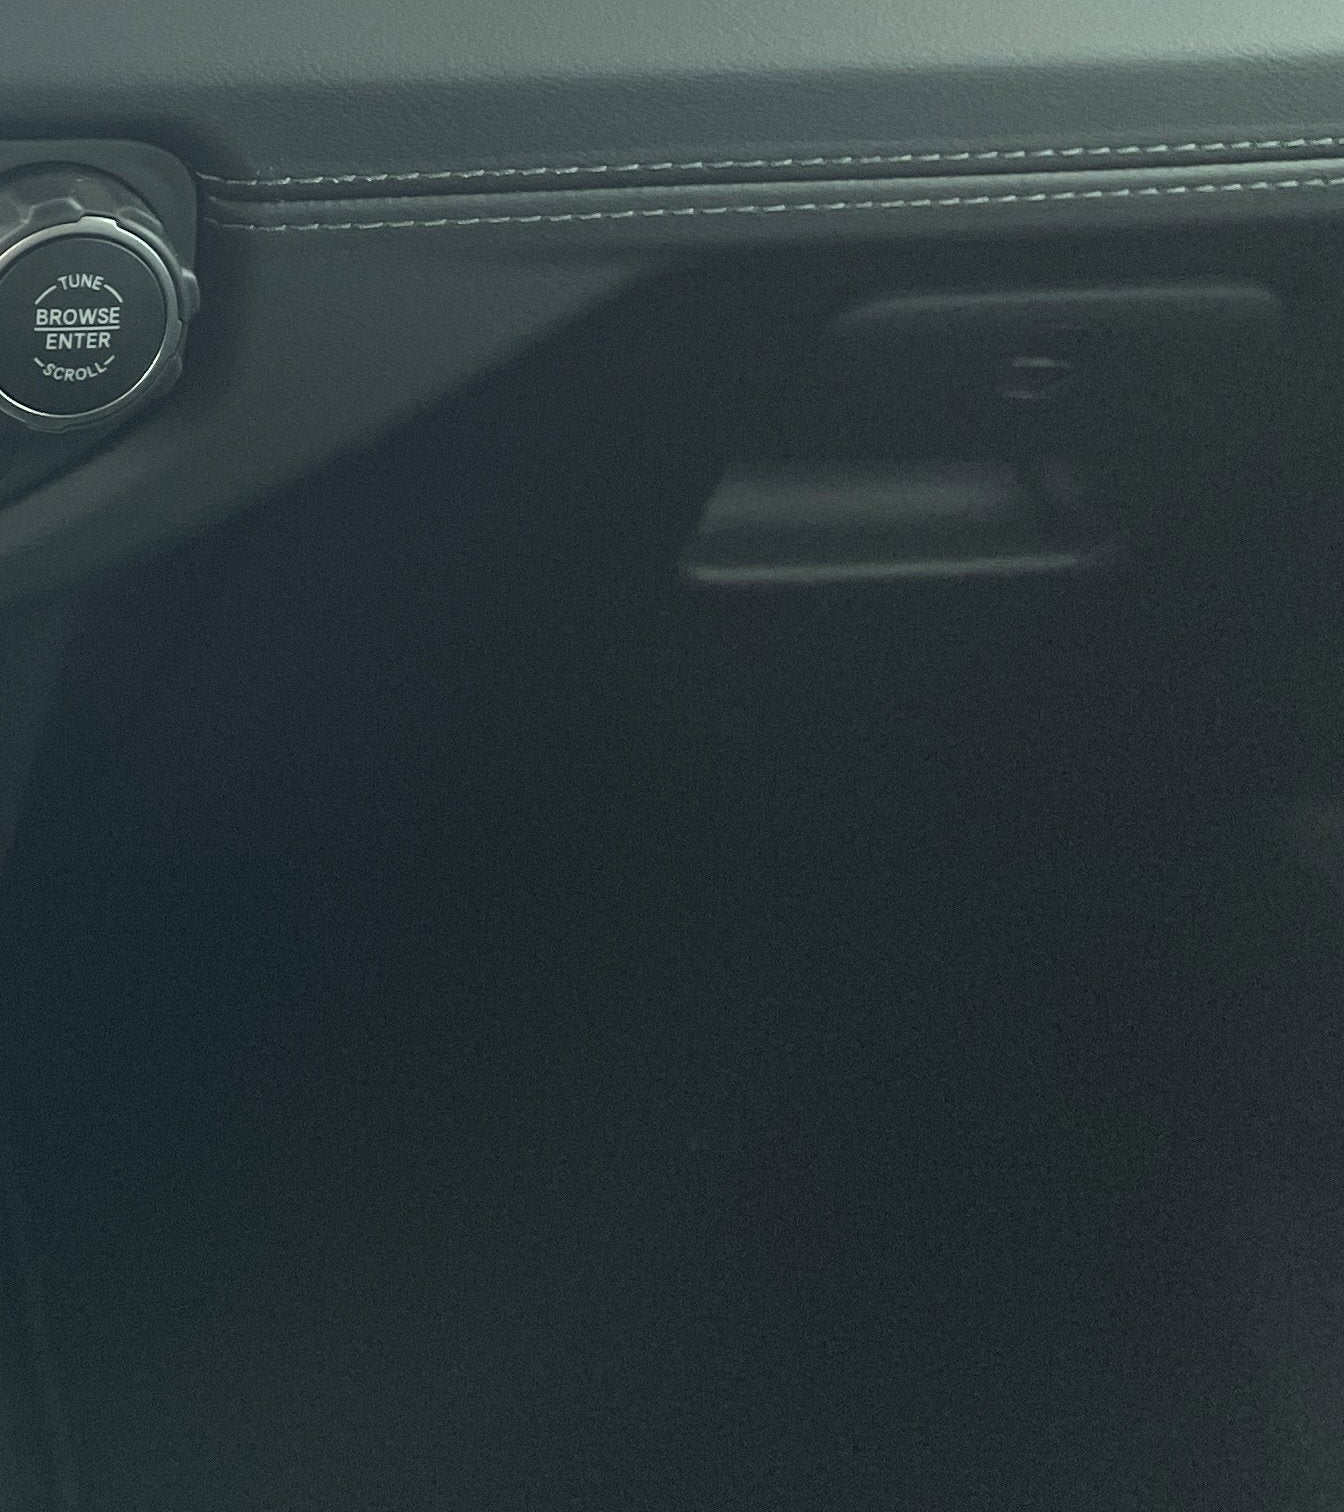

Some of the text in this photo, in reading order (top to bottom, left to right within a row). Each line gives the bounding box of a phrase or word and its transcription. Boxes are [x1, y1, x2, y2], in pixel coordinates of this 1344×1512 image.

[58, 274, 105, 291] TUNE
[35, 307, 120, 327] BROWSE
[45, 332, 111, 350] ENTER
[42, 362, 107, 382] SCROLL
